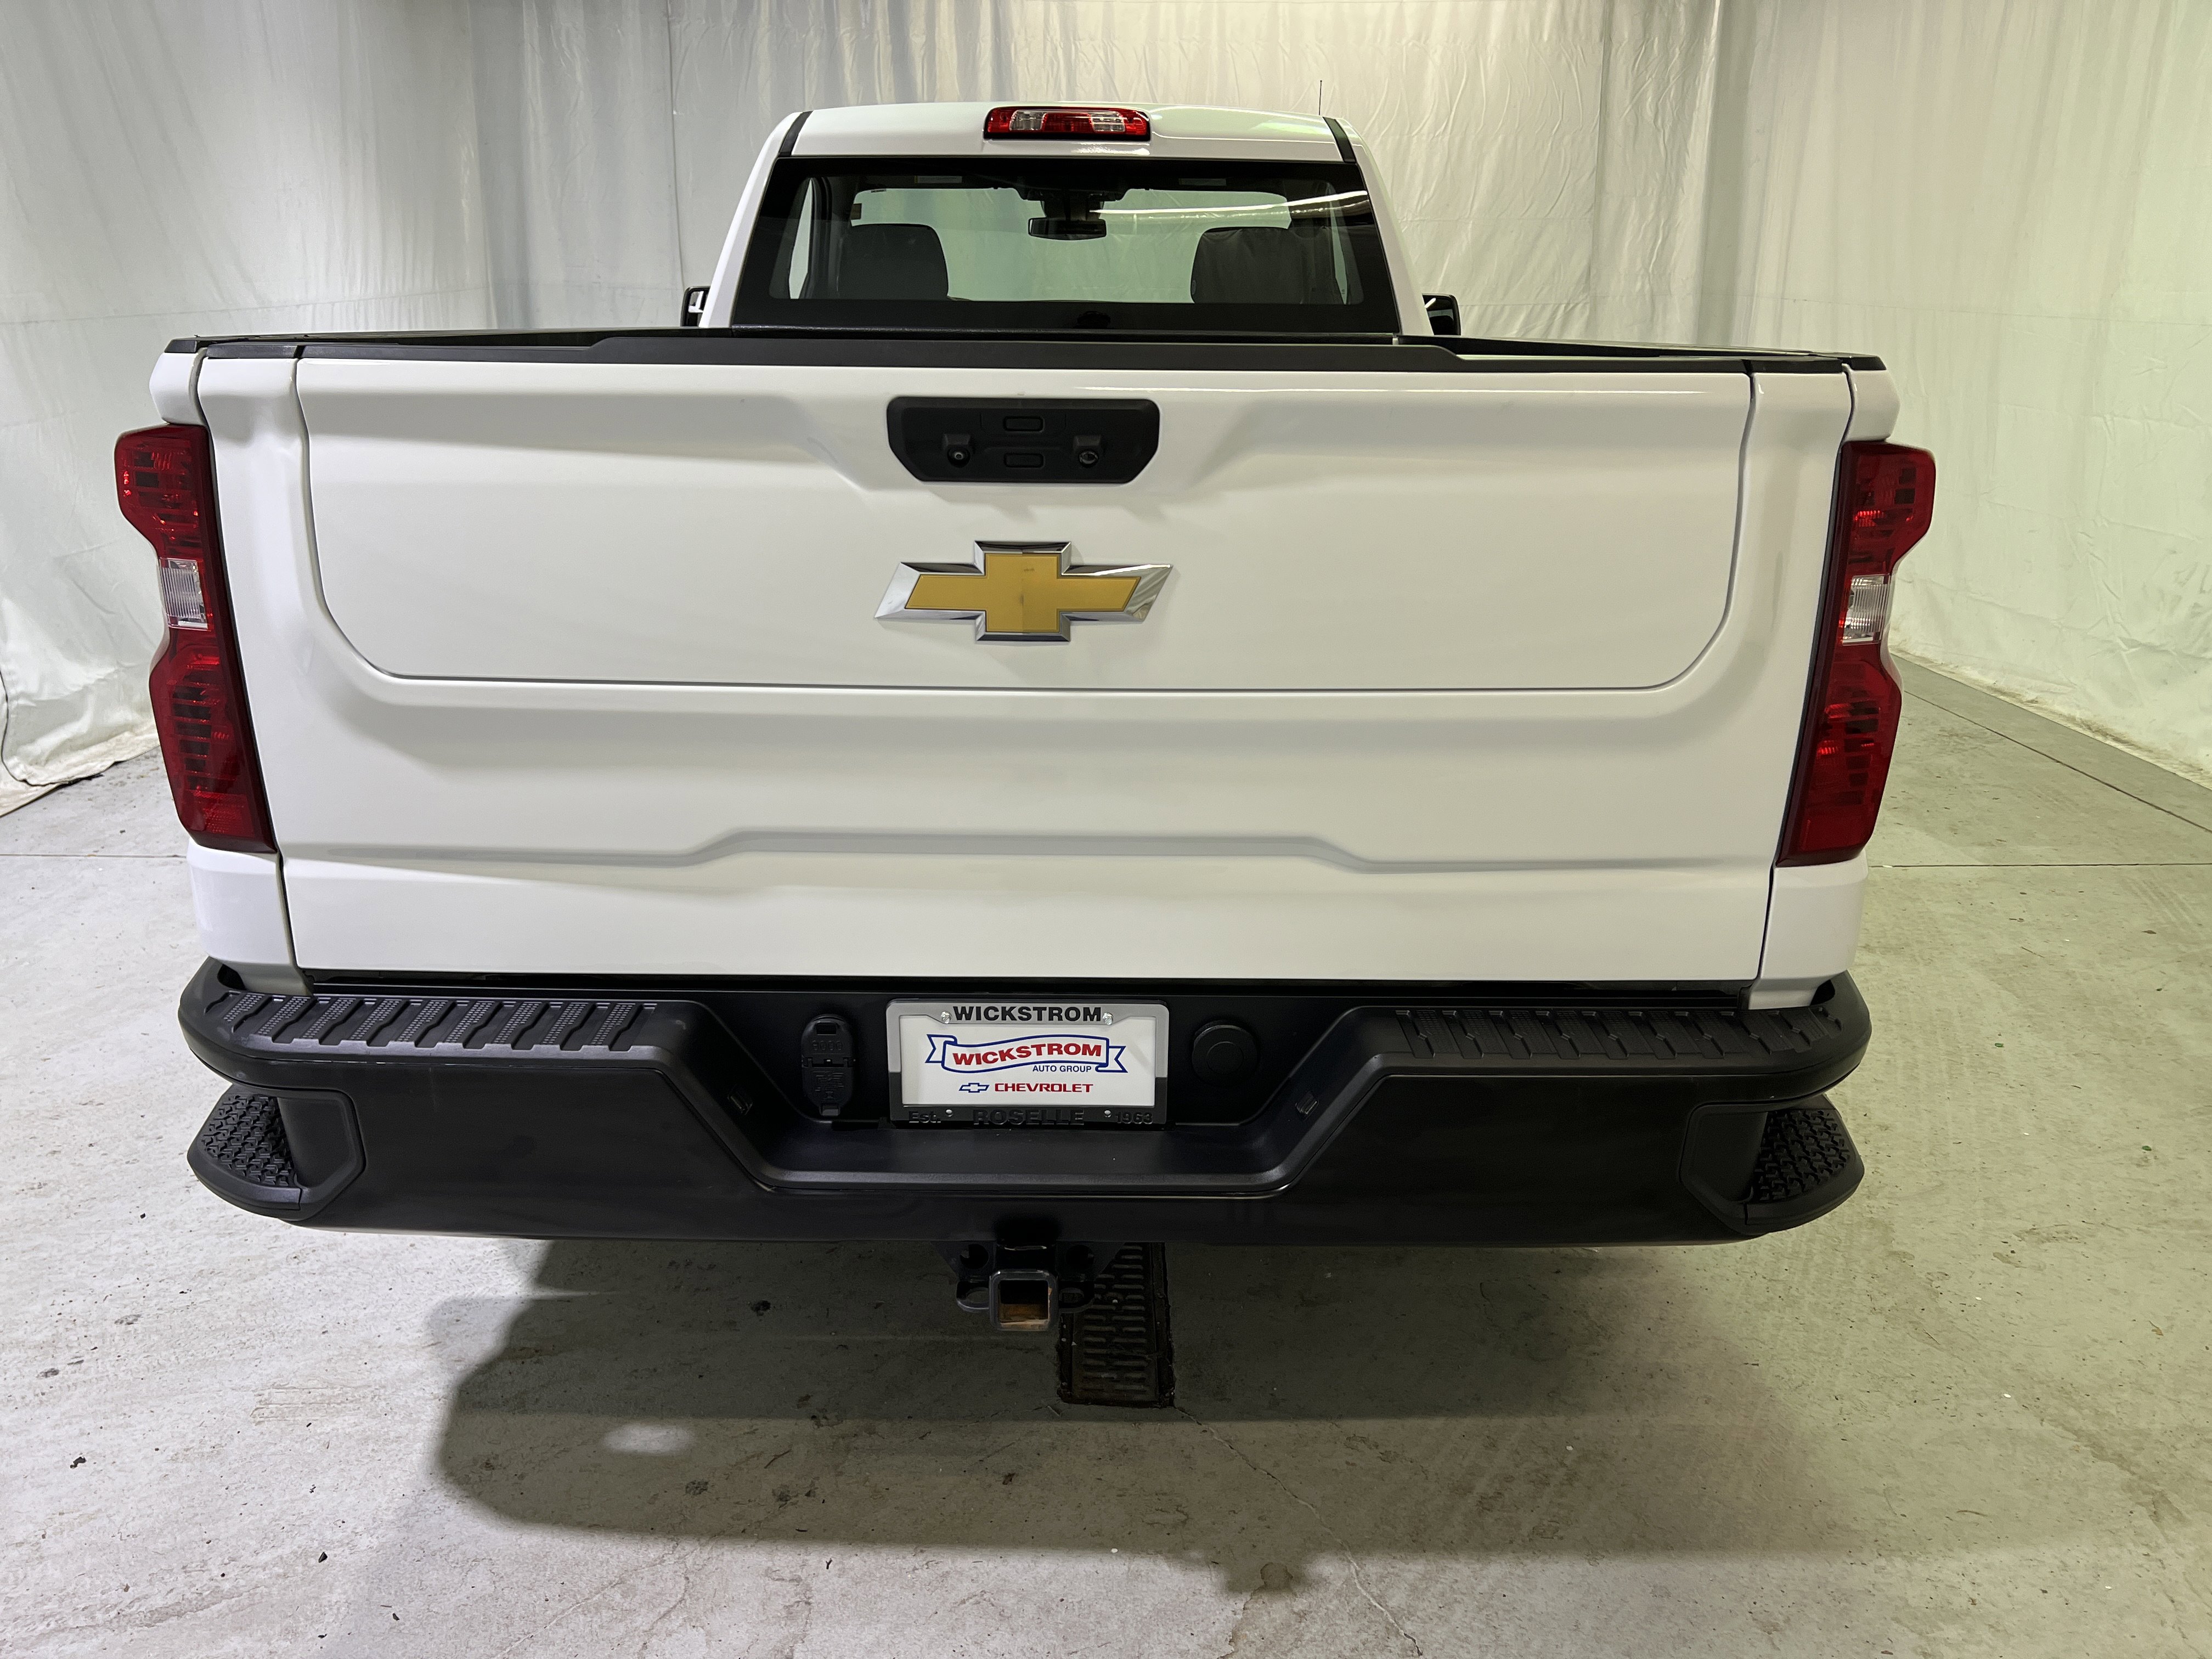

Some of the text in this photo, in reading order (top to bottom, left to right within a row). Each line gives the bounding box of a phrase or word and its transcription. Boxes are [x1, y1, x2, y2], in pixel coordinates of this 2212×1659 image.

[953, 1006, 1102, 1022] WICKSTROM
[952, 1043, 1102, 1065] WICKSTROM
[995, 1083, 1093, 1093] CHEVROLET
[909, 1109, 1153, 1125] Est. ROSELLE 1963
